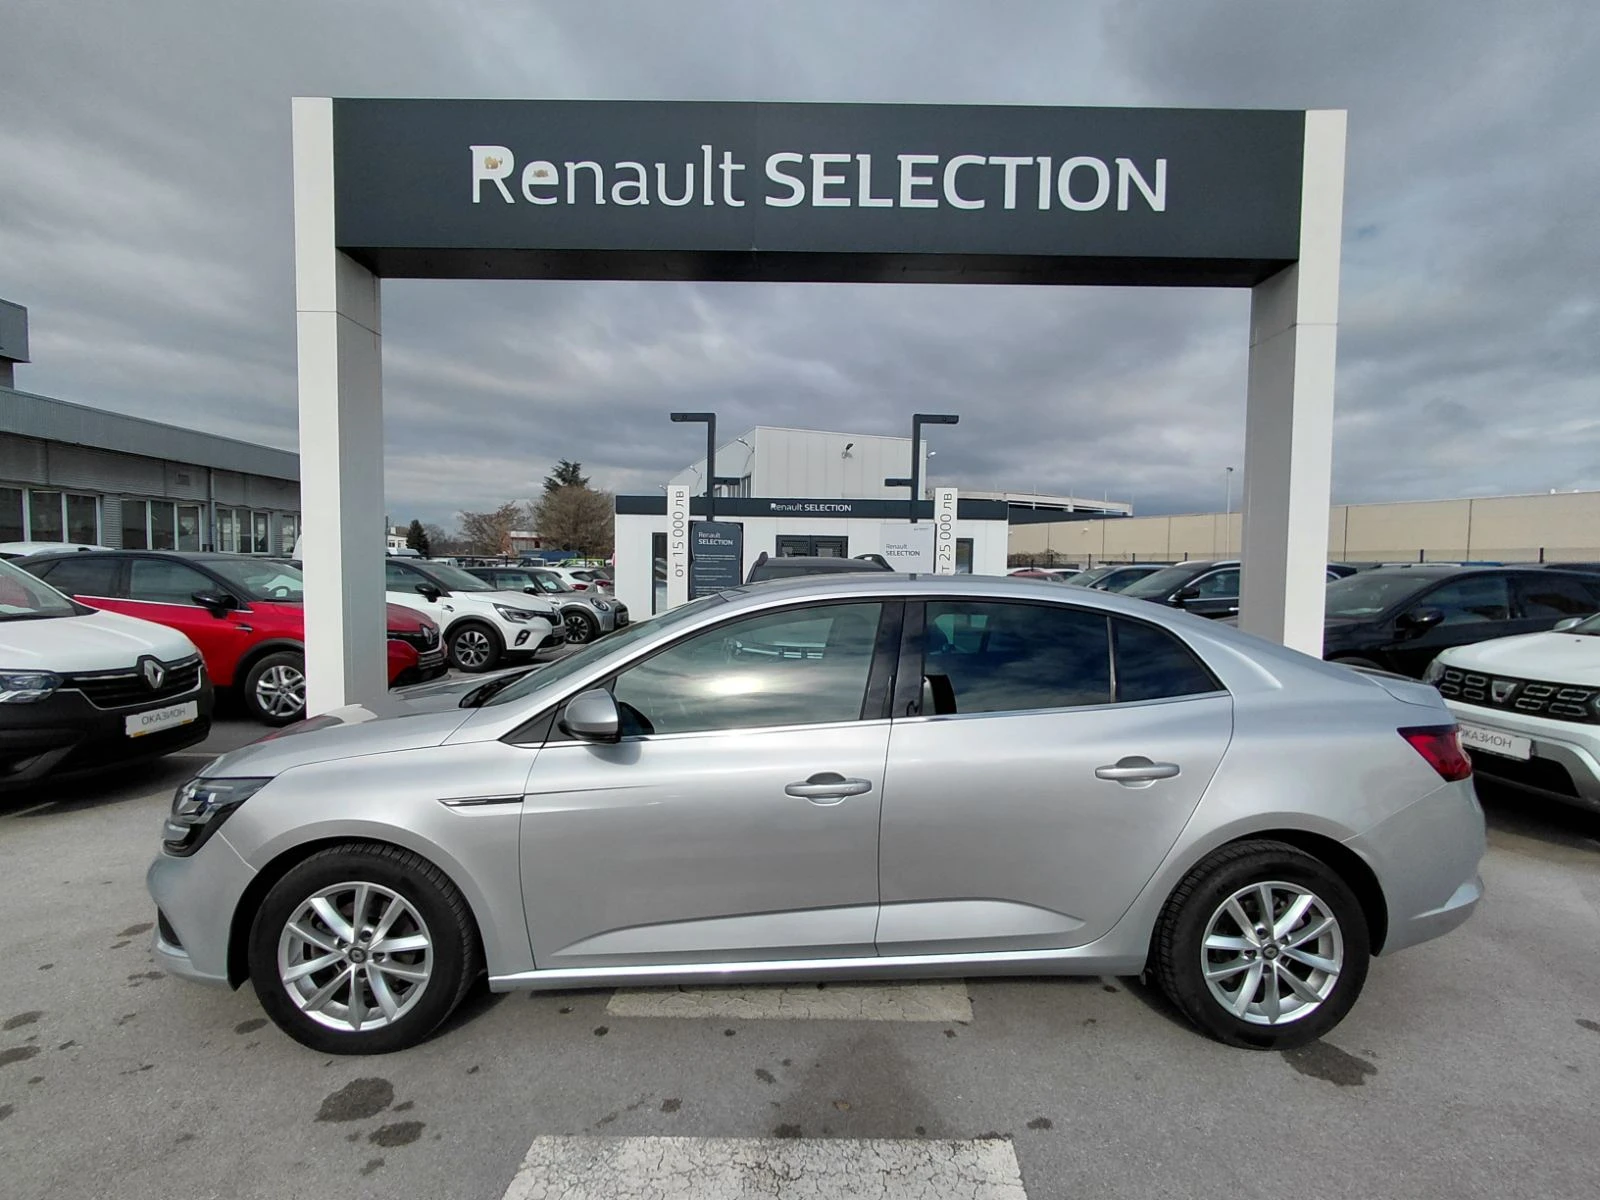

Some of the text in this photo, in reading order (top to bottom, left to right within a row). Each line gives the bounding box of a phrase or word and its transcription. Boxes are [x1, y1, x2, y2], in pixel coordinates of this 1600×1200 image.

[469, 144, 1168, 213] Renault SELECTION
[770, 502, 852, 512] Renault SELECTION
[698, 538, 734, 546] SELECTION
[141, 708, 186, 726] ОКАЗИОН
